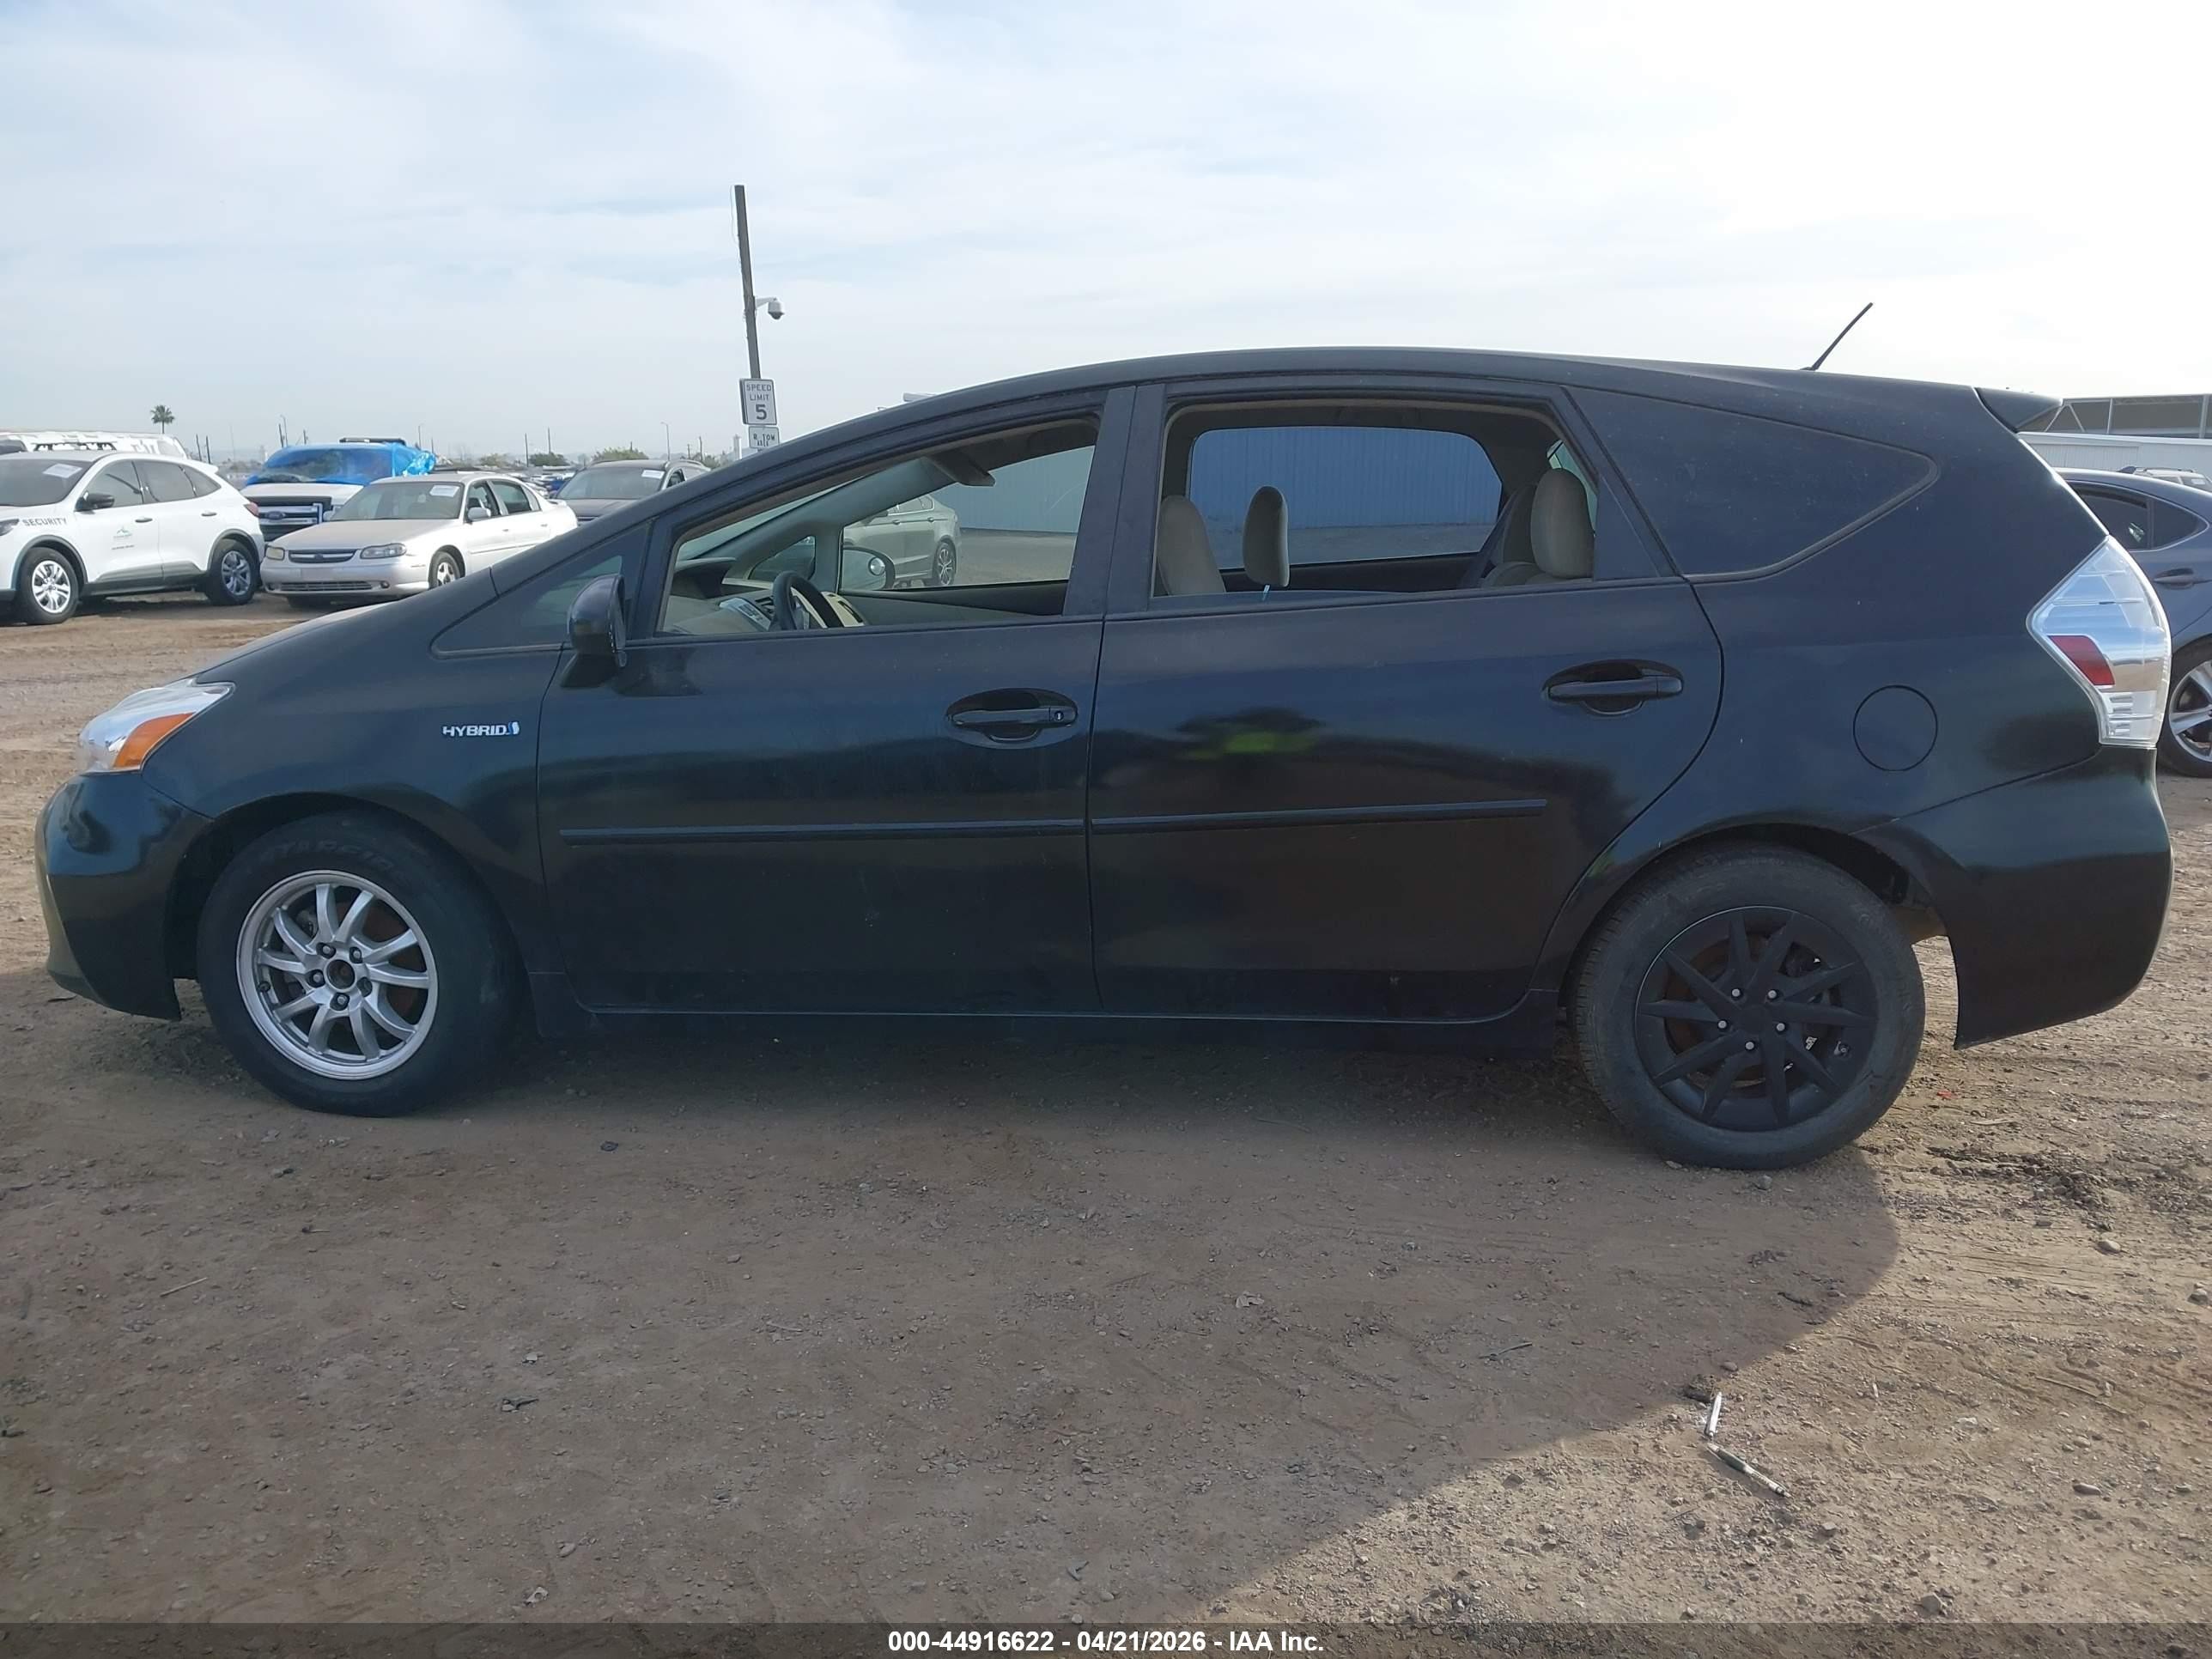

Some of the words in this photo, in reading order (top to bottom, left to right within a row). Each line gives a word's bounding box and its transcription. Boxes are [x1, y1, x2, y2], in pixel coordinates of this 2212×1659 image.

[756, 404, 767, 420] 5
[22, 518, 67, 526] SECURITY
[442, 725, 507, 737] HYBRID
